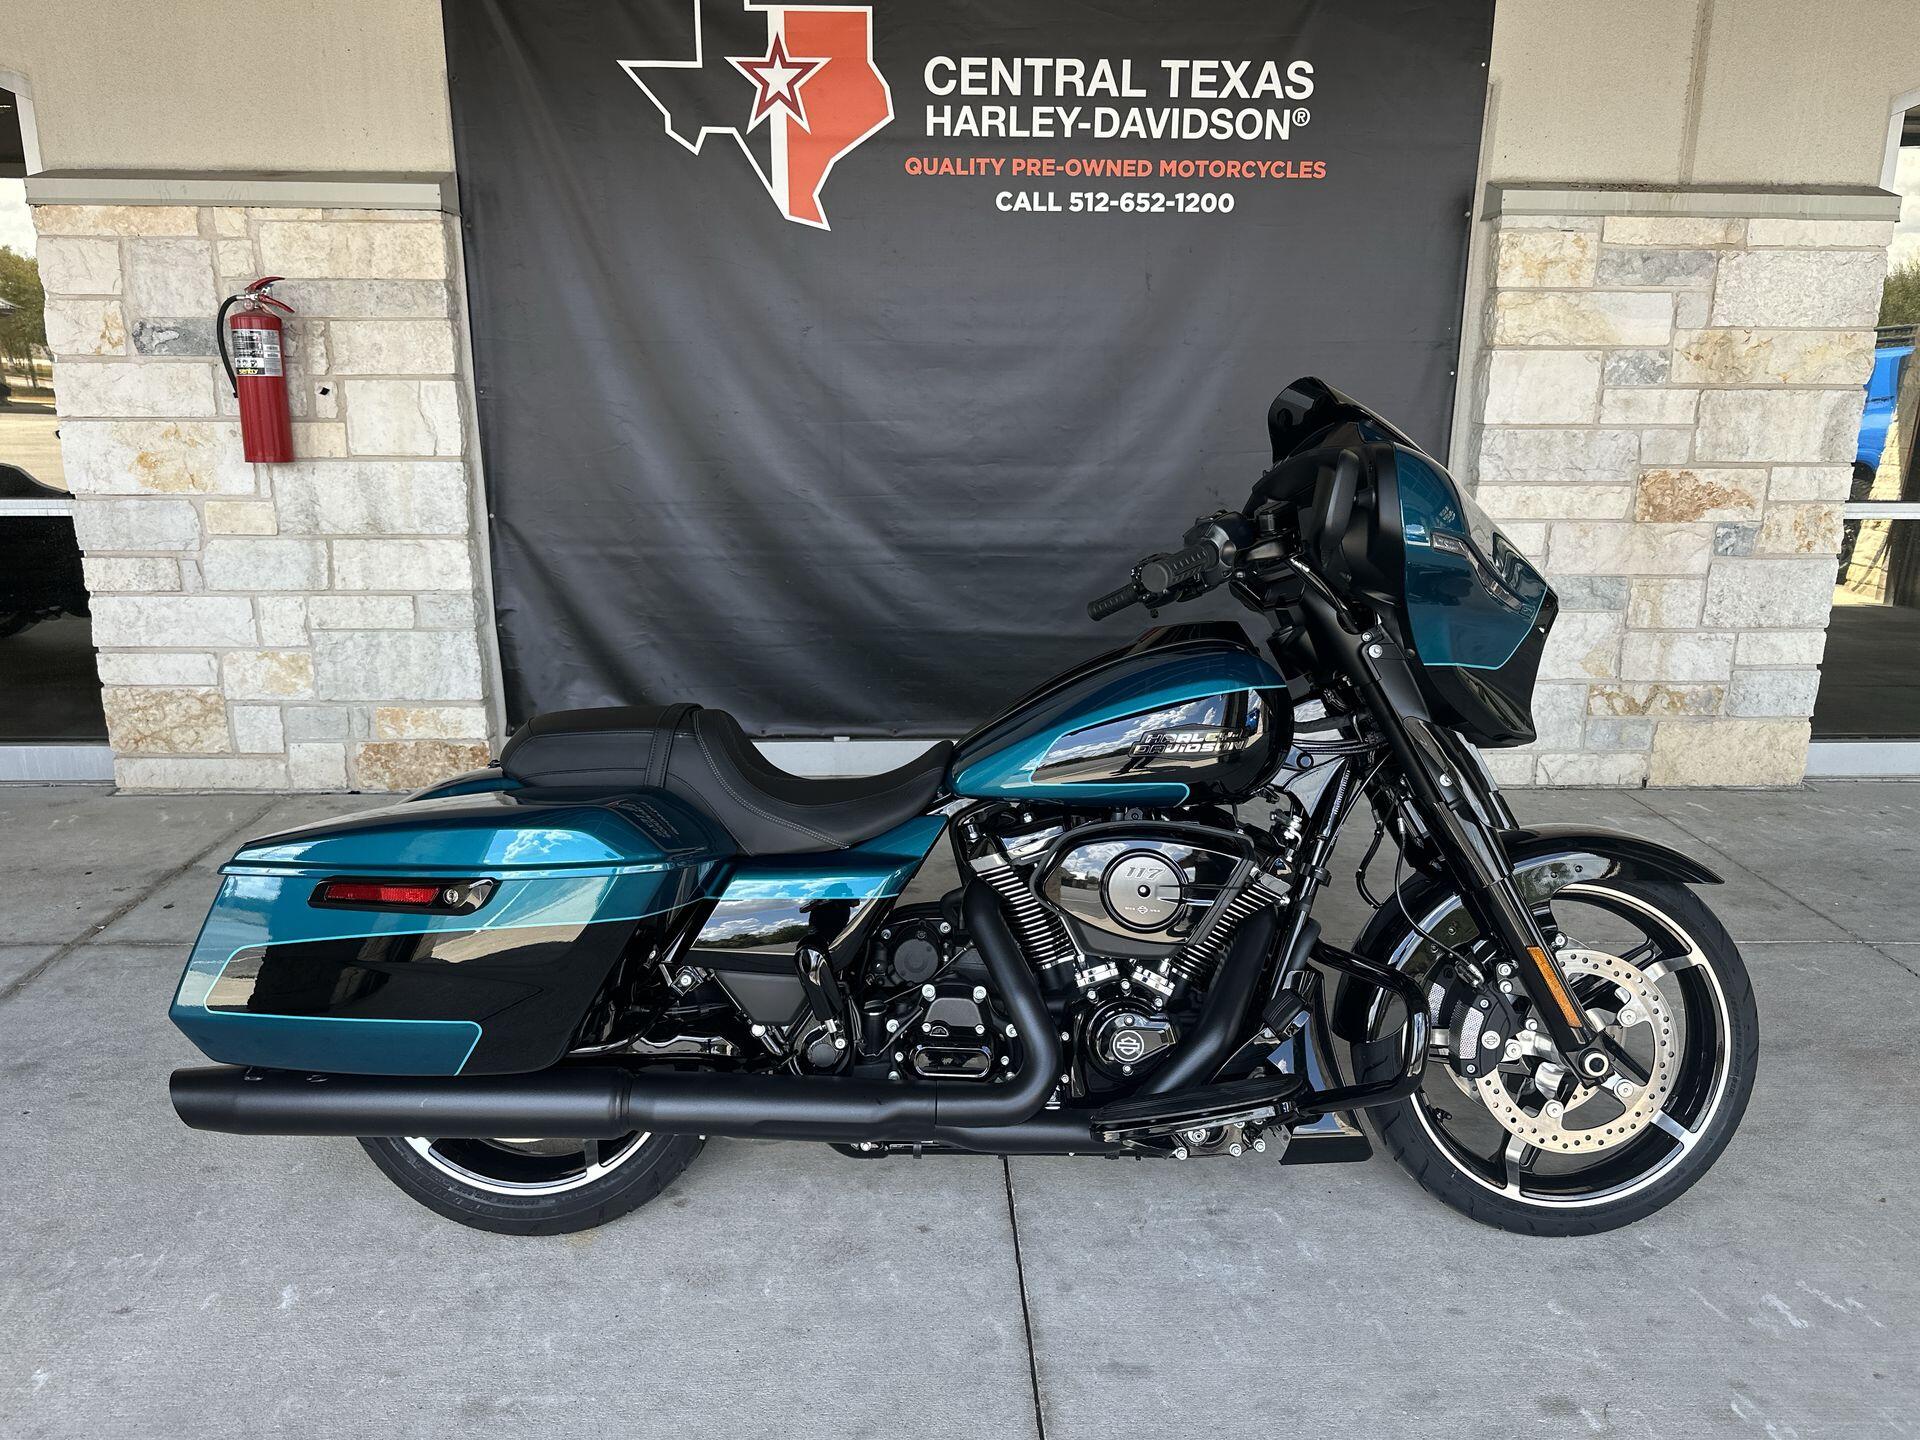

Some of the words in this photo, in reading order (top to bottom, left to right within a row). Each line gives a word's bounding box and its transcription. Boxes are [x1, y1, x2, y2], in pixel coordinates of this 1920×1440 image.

[924, 56, 1146, 97] CENTRAL
[1161, 60, 1314, 99] TEXAS
[905, 157, 1006, 175] QUALITY
[1012, 158, 1152, 177] PRE-OWNED
[1160, 160, 1326, 178] MOTORCYCLES
[996, 191, 1062, 211] CALL
[1069, 192, 1234, 213] 512-652-1200
[1126, 867, 1164, 879] 117
